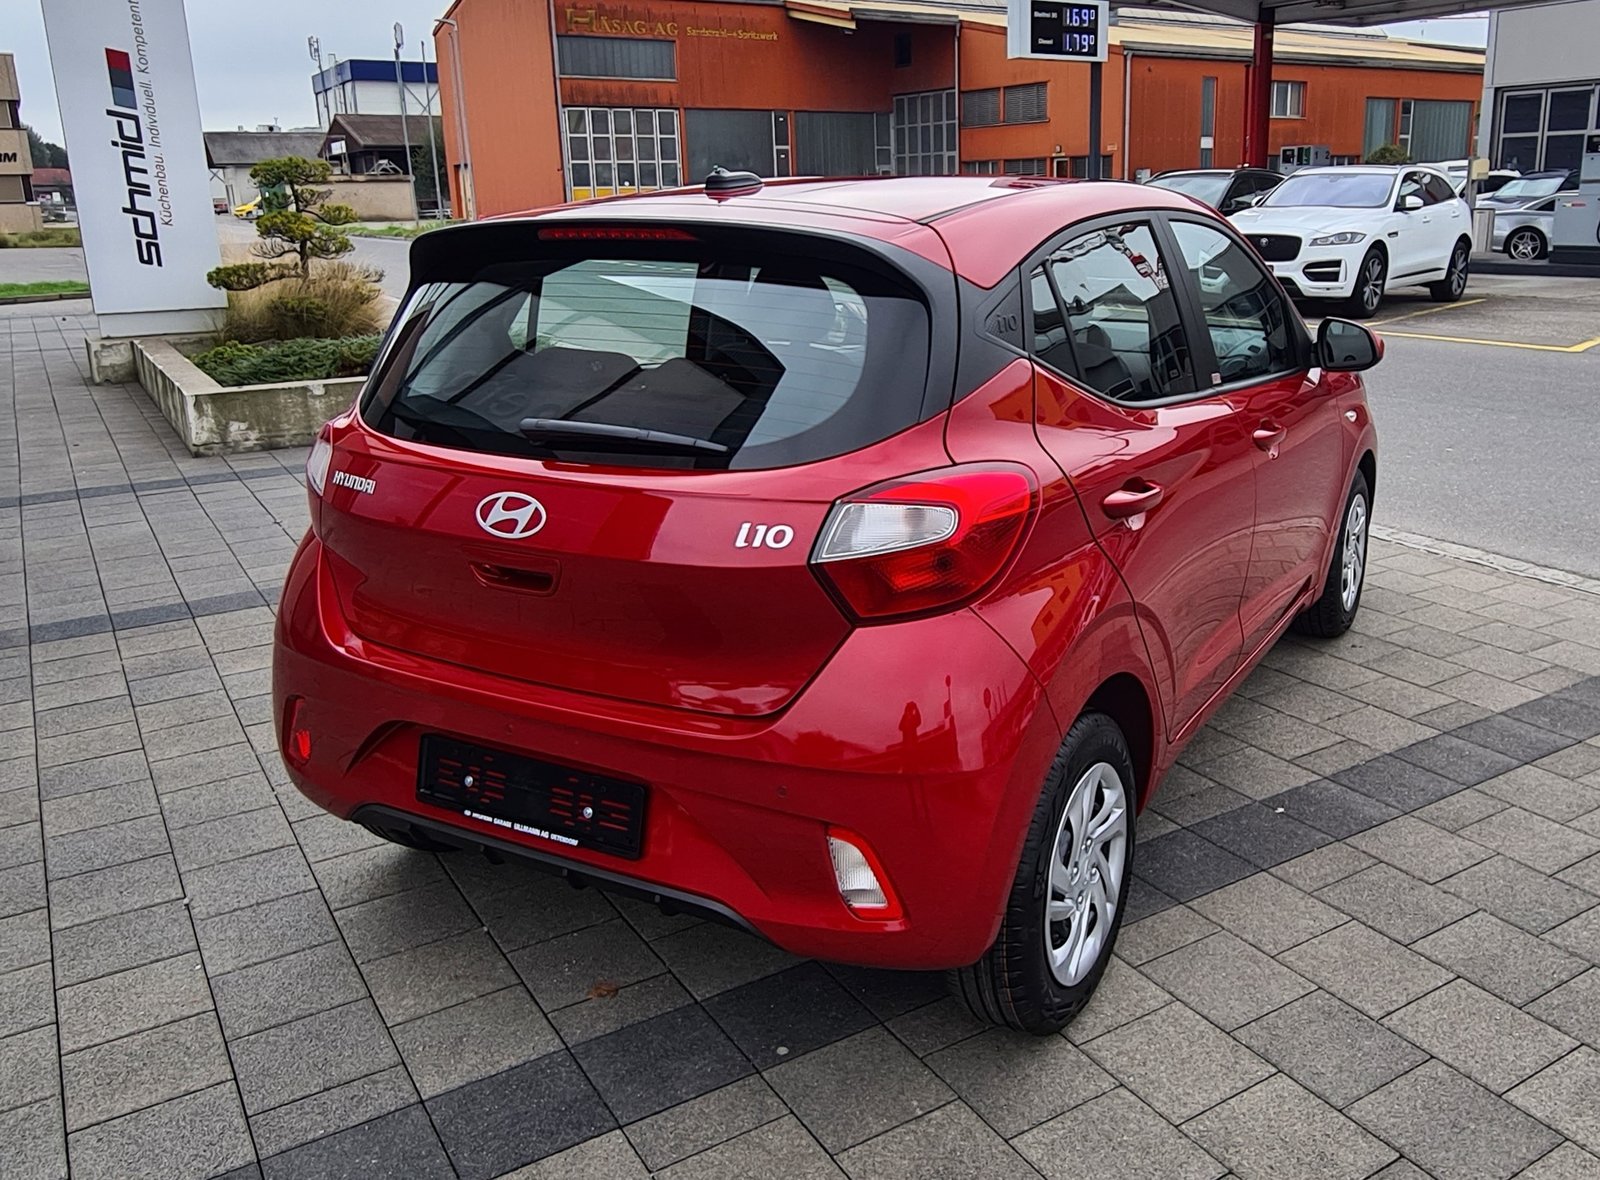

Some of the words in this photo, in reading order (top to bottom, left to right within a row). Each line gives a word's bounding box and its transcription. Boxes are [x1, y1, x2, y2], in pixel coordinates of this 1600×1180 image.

[566, 8, 646, 35] HÄSAG
[654, 22, 678, 36] AG
[138, 79, 161, 148] Individuell.
[0, 152, 17, 163] M
[105, 108, 163, 267] schmid
[153, 152, 174, 227] Küchenbau.
[332, 470, 376, 494] HYUNDAI
